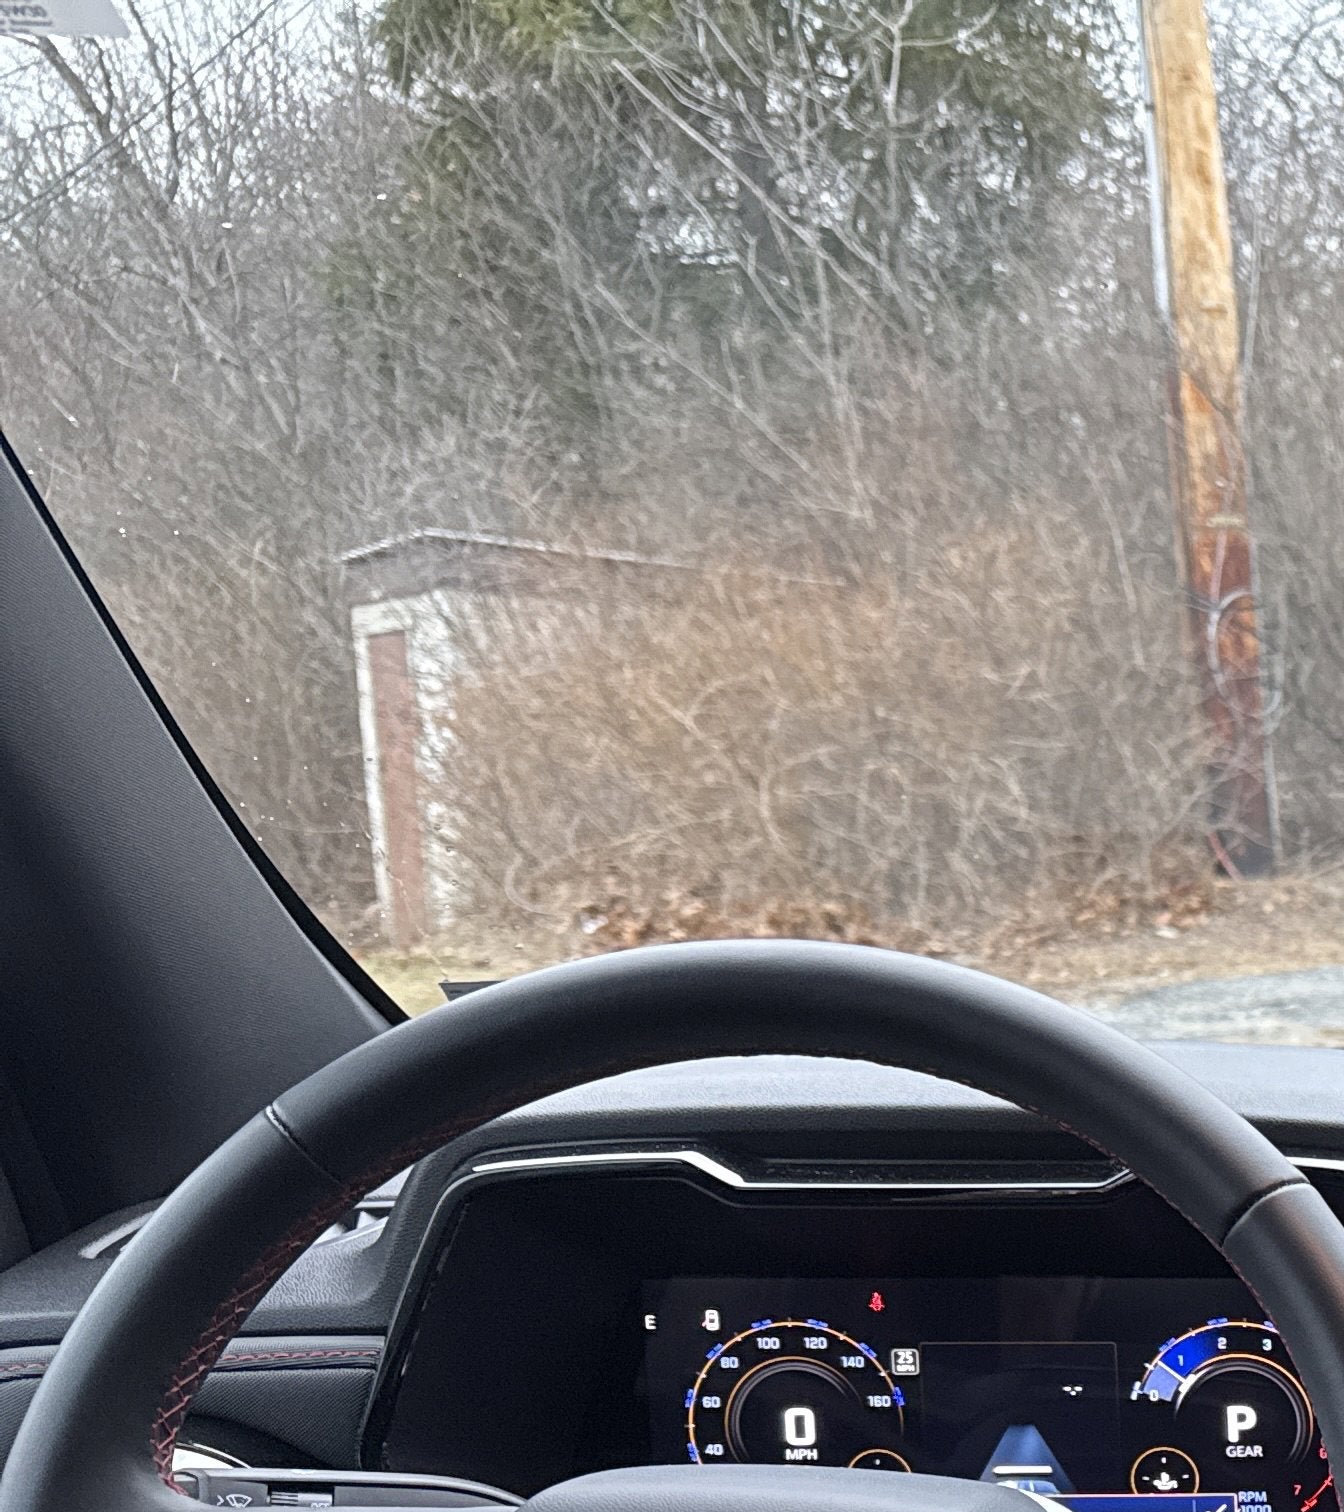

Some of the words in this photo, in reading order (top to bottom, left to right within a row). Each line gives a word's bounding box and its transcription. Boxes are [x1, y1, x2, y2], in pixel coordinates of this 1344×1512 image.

[645, 1314, 656, 1330] E
[756, 1337, 780, 1350] 100
[803, 1337, 828, 1350] 120
[1217, 1337, 1227, 1349] 2
[1262, 1339, 1272, 1351] 3
[720, 1356, 739, 1368] 80
[840, 1356, 865, 1368] 140
[897, 1351, 914, 1364] 25
[1177, 1355, 1184, 1366] 1
[702, 1396, 721, 1408] 60
[867, 1396, 891, 1408] 160
[784, 1407, 816, 1446] 0
[1226, 1405, 1257, 1443] P
[704, 1444, 723, 1456] 40
[785, 1449, 818, 1460] MPH
[1225, 1445, 1263, 1458] GEAR
[1319, 1448, 1328, 1459] 6
[1293, 1484, 1302, 1496] 7
[1238, 1491, 1268, 1503] RPM
